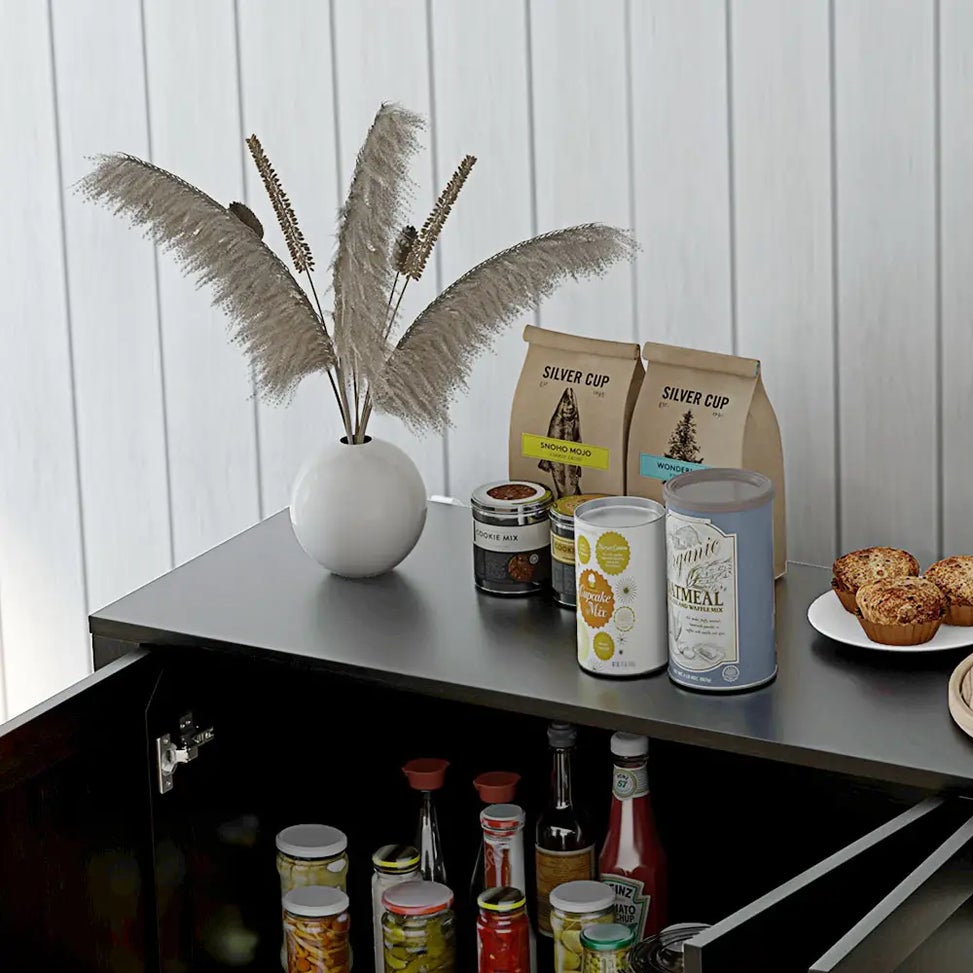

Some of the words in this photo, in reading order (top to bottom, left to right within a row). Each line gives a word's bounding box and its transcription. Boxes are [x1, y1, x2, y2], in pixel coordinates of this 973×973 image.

[542, 365, 583, 384] SILVER
[585, 372, 610, 388] CUP
[662, 386, 702, 405] SILVER
[704, 394, 730, 410] CUP
[540, 442, 568, 453] SNOHO
[569, 448, 592, 457] MOJO
[502, 534, 519, 542] MIX
[586, 601, 608, 619] Mix
